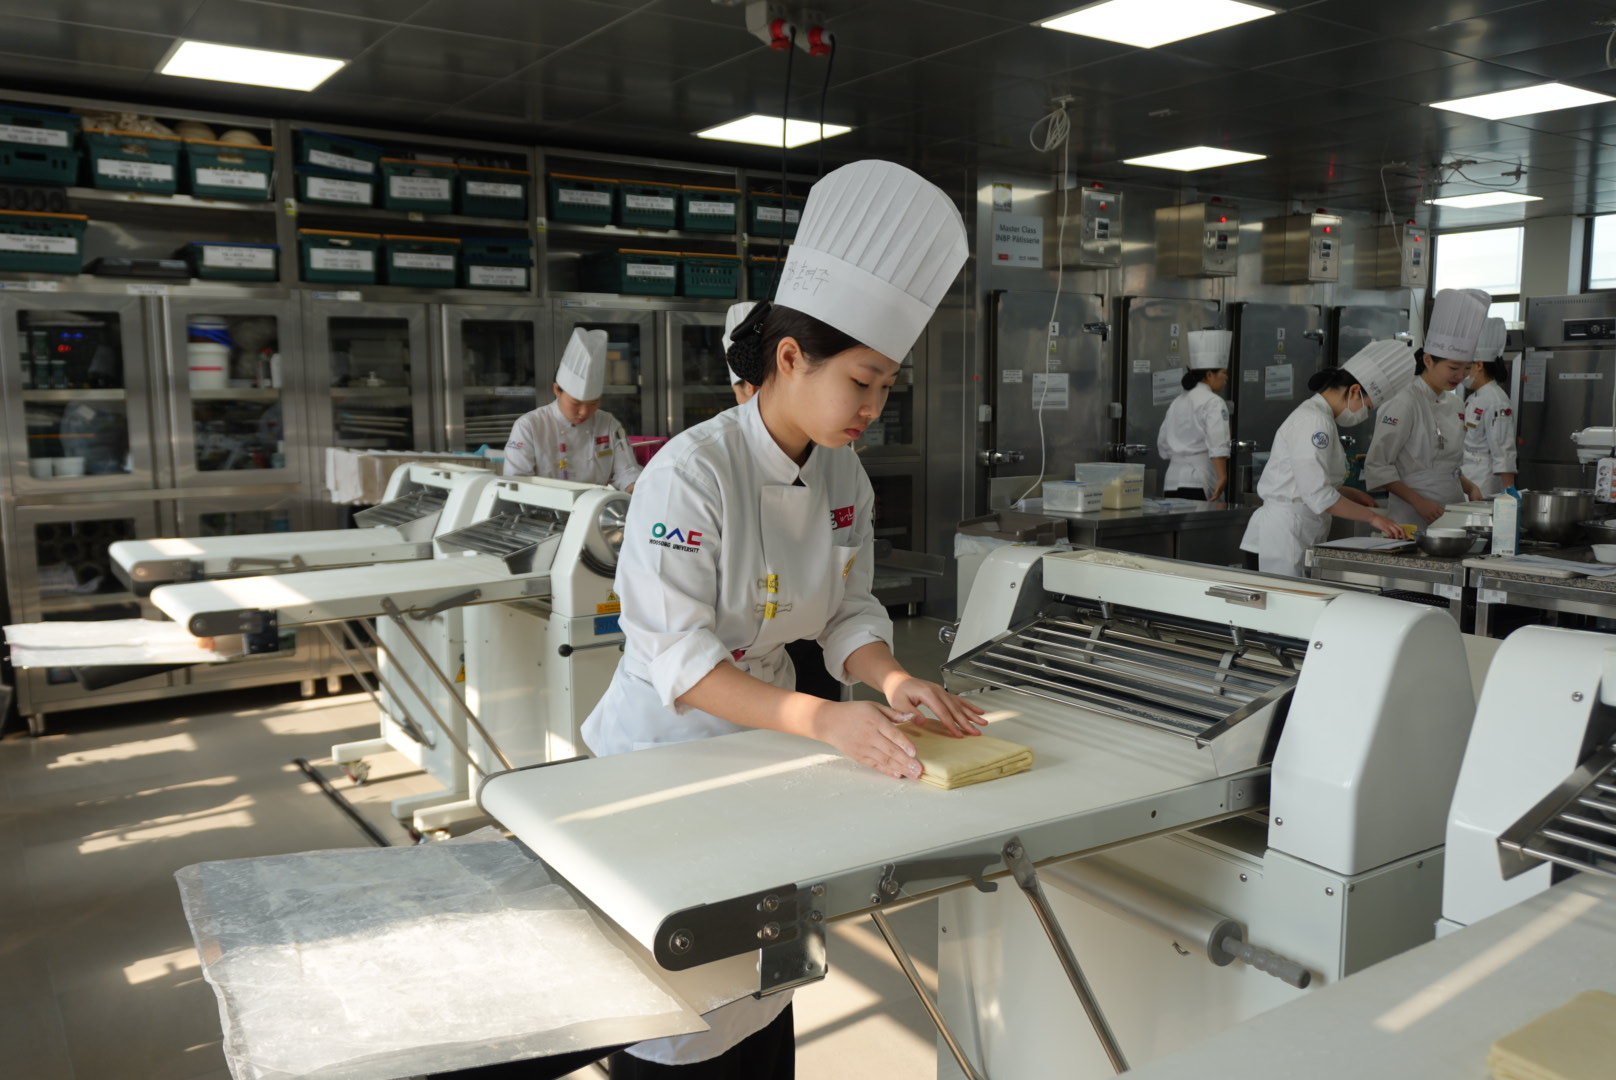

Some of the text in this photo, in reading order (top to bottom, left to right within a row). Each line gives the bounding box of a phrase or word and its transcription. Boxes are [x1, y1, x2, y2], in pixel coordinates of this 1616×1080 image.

[1000, 224, 1036, 234] Master Class
[672, 543, 700, 553] UNIVERSITY
